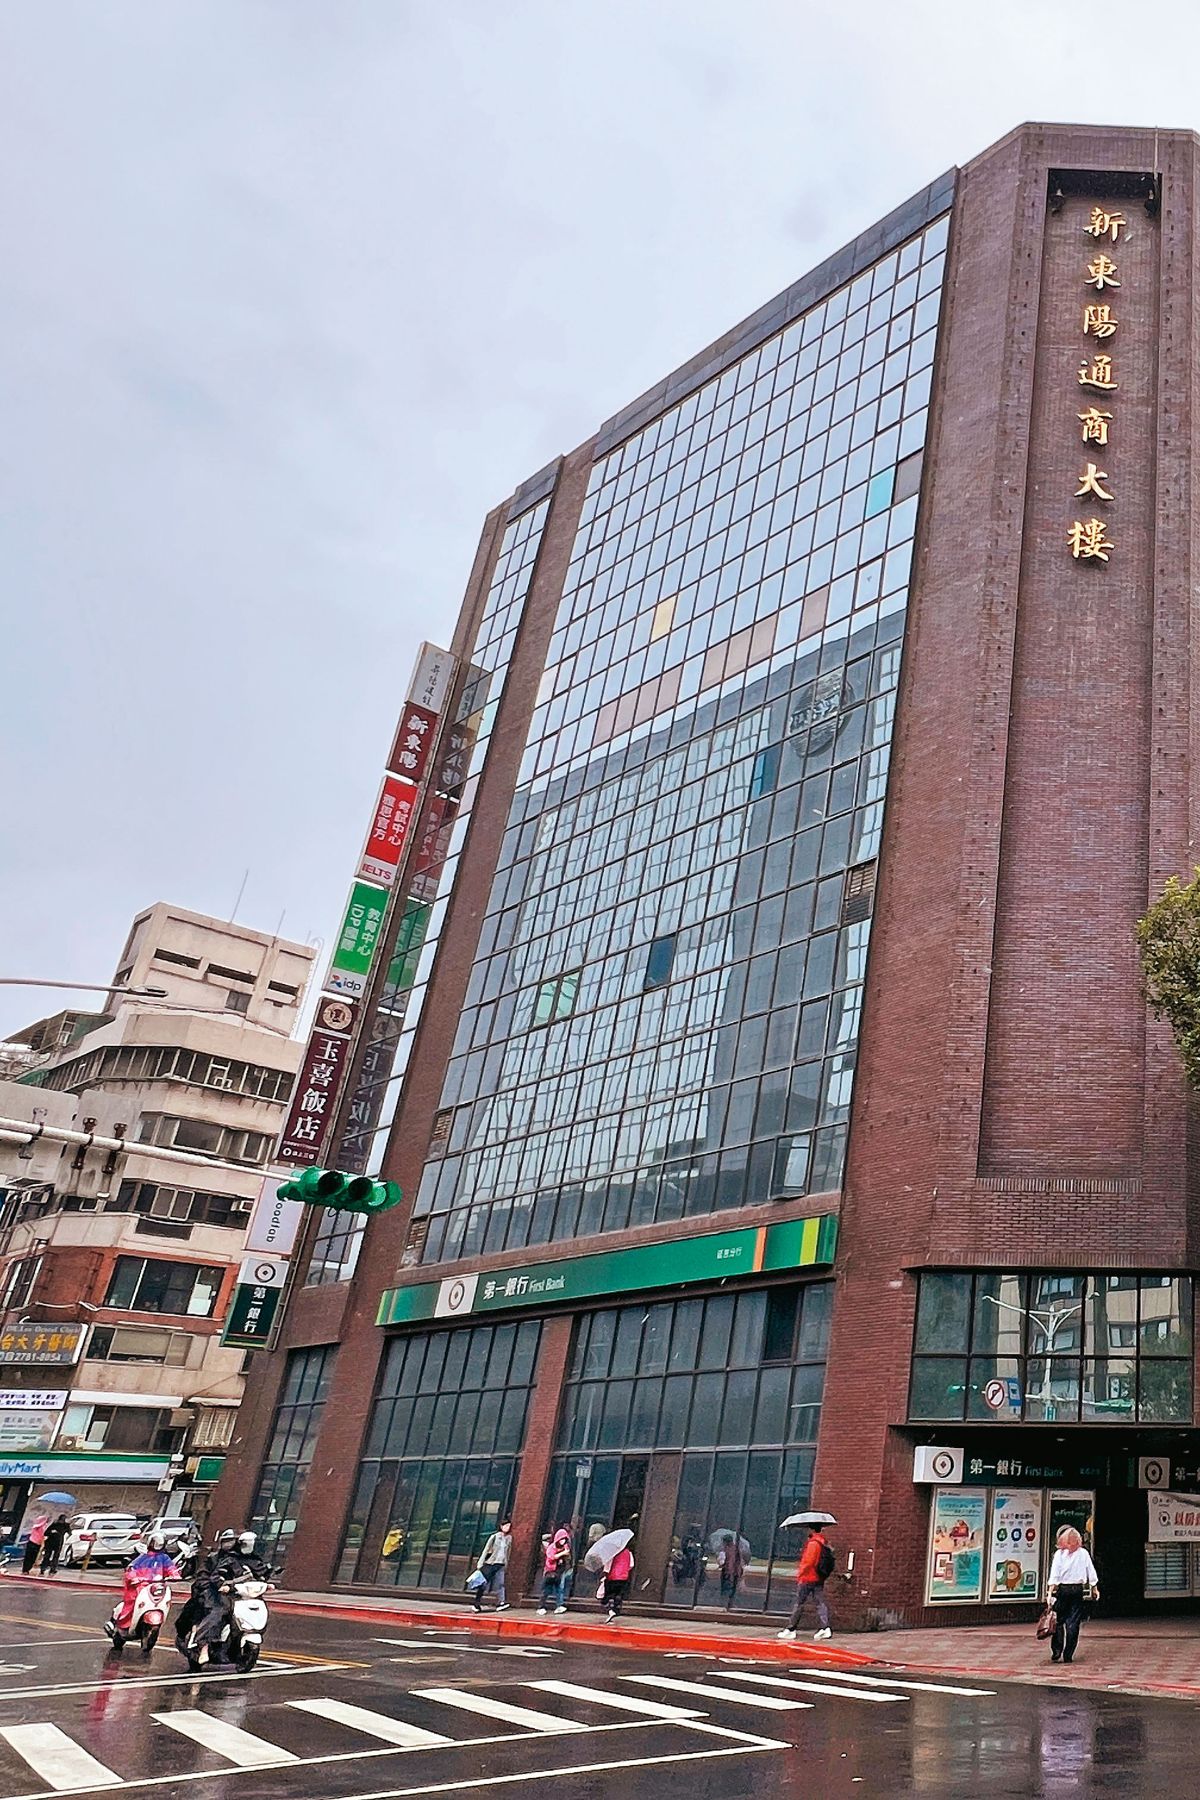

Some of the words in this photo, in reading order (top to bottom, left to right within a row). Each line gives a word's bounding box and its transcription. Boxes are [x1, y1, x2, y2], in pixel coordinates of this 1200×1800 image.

[1067, 207, 1127, 562] 新東陽通商大樓
[399, 714, 429, 769] 新東陽
[387, 800, 412, 846] 考試中心
[361, 863, 393, 881] IELTS
[357, 907, 381, 957] 教育中心
[343, 977, 362, 992] idp
[291, 1037, 342, 1141] 玉喜飯店
[266, 1198, 287, 1243] oodlab
[243, 1286, 267, 1333] 第一銀行
[483, 1275, 530, 1300] 第一銀行
[529, 1279, 545, 1293] First
[546, 1275, 566, 1290] Bank
[0, 1462, 42, 1474] ilyMart
[970, 1458, 1022, 1476] 第一銀行
[1025, 1465, 1042, 1476] First
